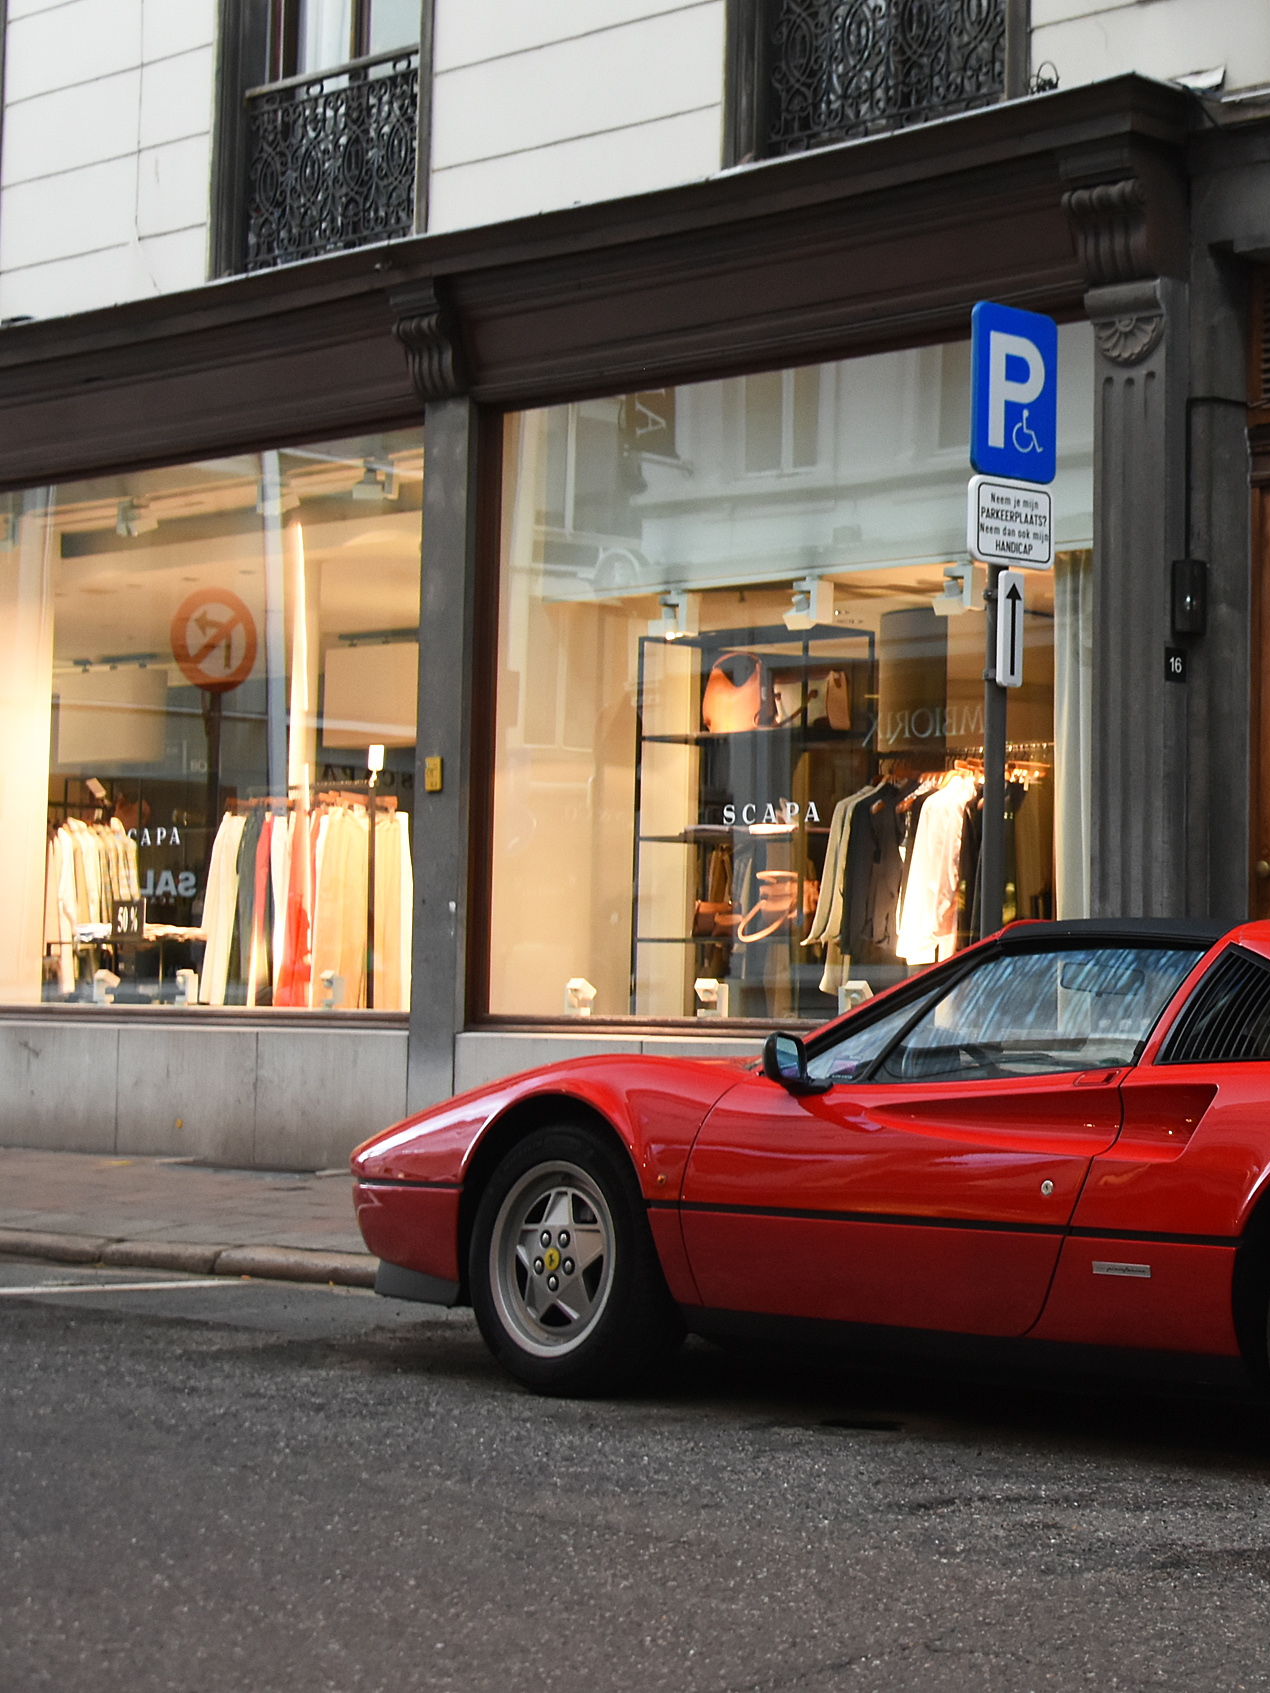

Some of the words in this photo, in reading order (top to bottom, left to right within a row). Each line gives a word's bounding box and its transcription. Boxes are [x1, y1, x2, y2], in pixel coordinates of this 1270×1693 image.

[988, 330, 1046, 449] P
[990, 492, 1011, 505] Neem
[1013, 496, 1021, 509] je
[1023, 499, 1039, 511] mijn
[980, 506, 1047, 528] PARKEERPLAATS?
[980, 522, 1000, 535] Neem
[1002, 525, 1016, 537] dan
[1018, 528, 1030, 539] ook
[1032, 530, 1049, 544] mijn
[995, 539, 1033, 555] HANDICAP
[1169, 656, 1182, 673] 16
[722, 801, 820, 825] SCAPA
[127, 826, 181, 846] CAPA
[117, 905, 128, 933] 50
